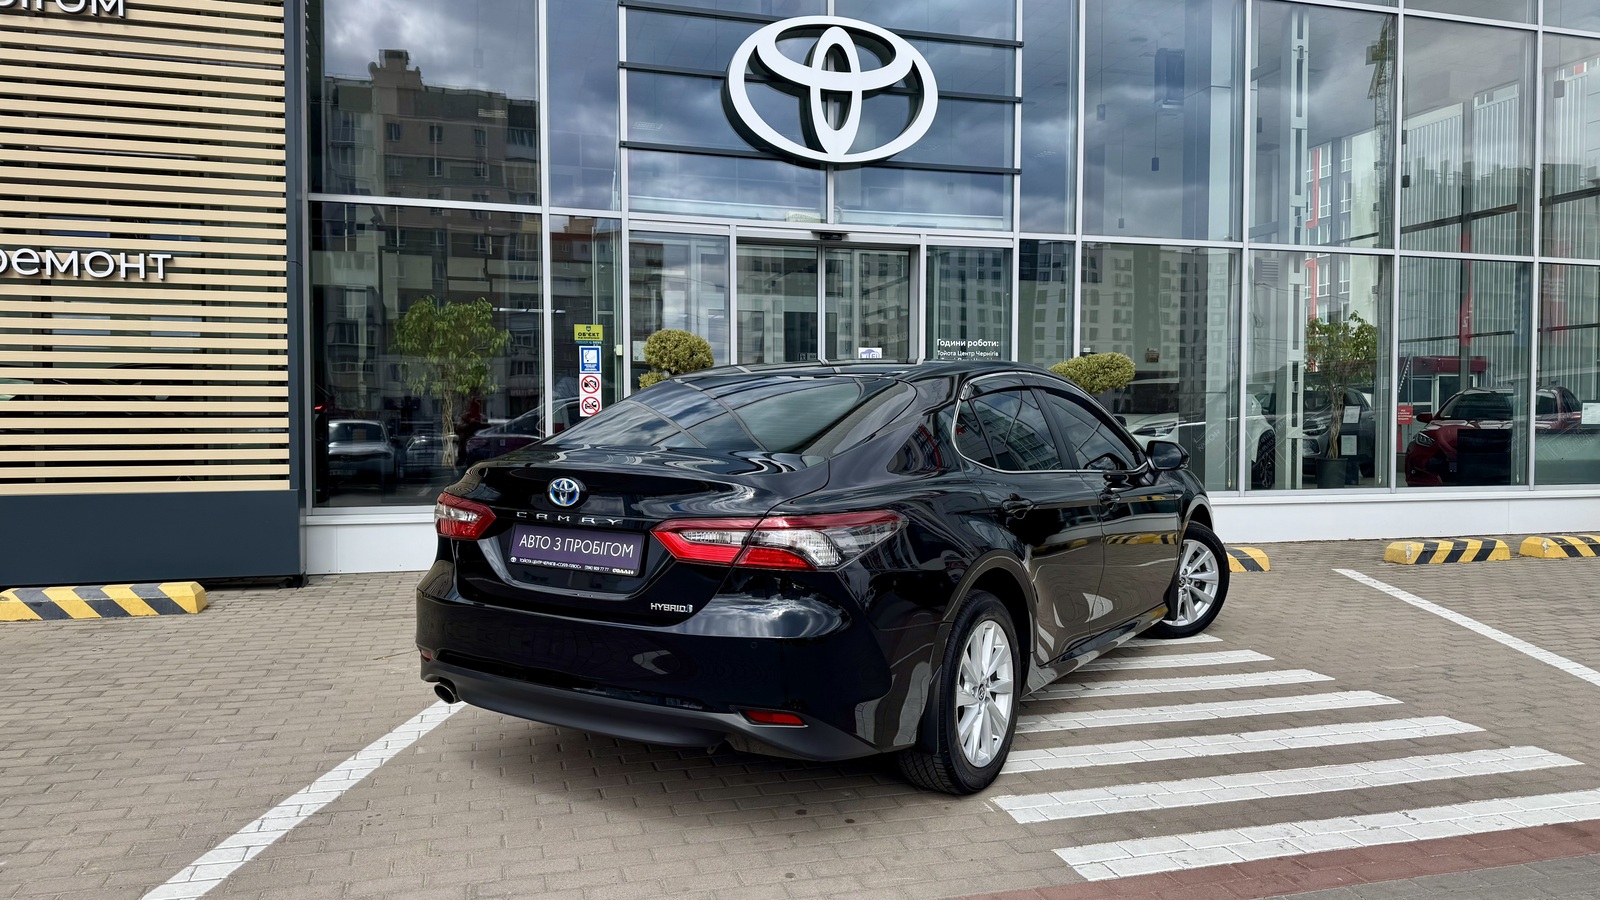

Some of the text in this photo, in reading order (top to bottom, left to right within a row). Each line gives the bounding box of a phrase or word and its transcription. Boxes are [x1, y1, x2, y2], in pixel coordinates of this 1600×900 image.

[0, 248, 172, 280] емонт
[937, 339, 999, 348] Години роботи:
[516, 511, 622, 525] CAMRY
[519, 534, 634, 558] АВТО З ПРОБІГОМ
[650, 602, 686, 613] HYBRID
